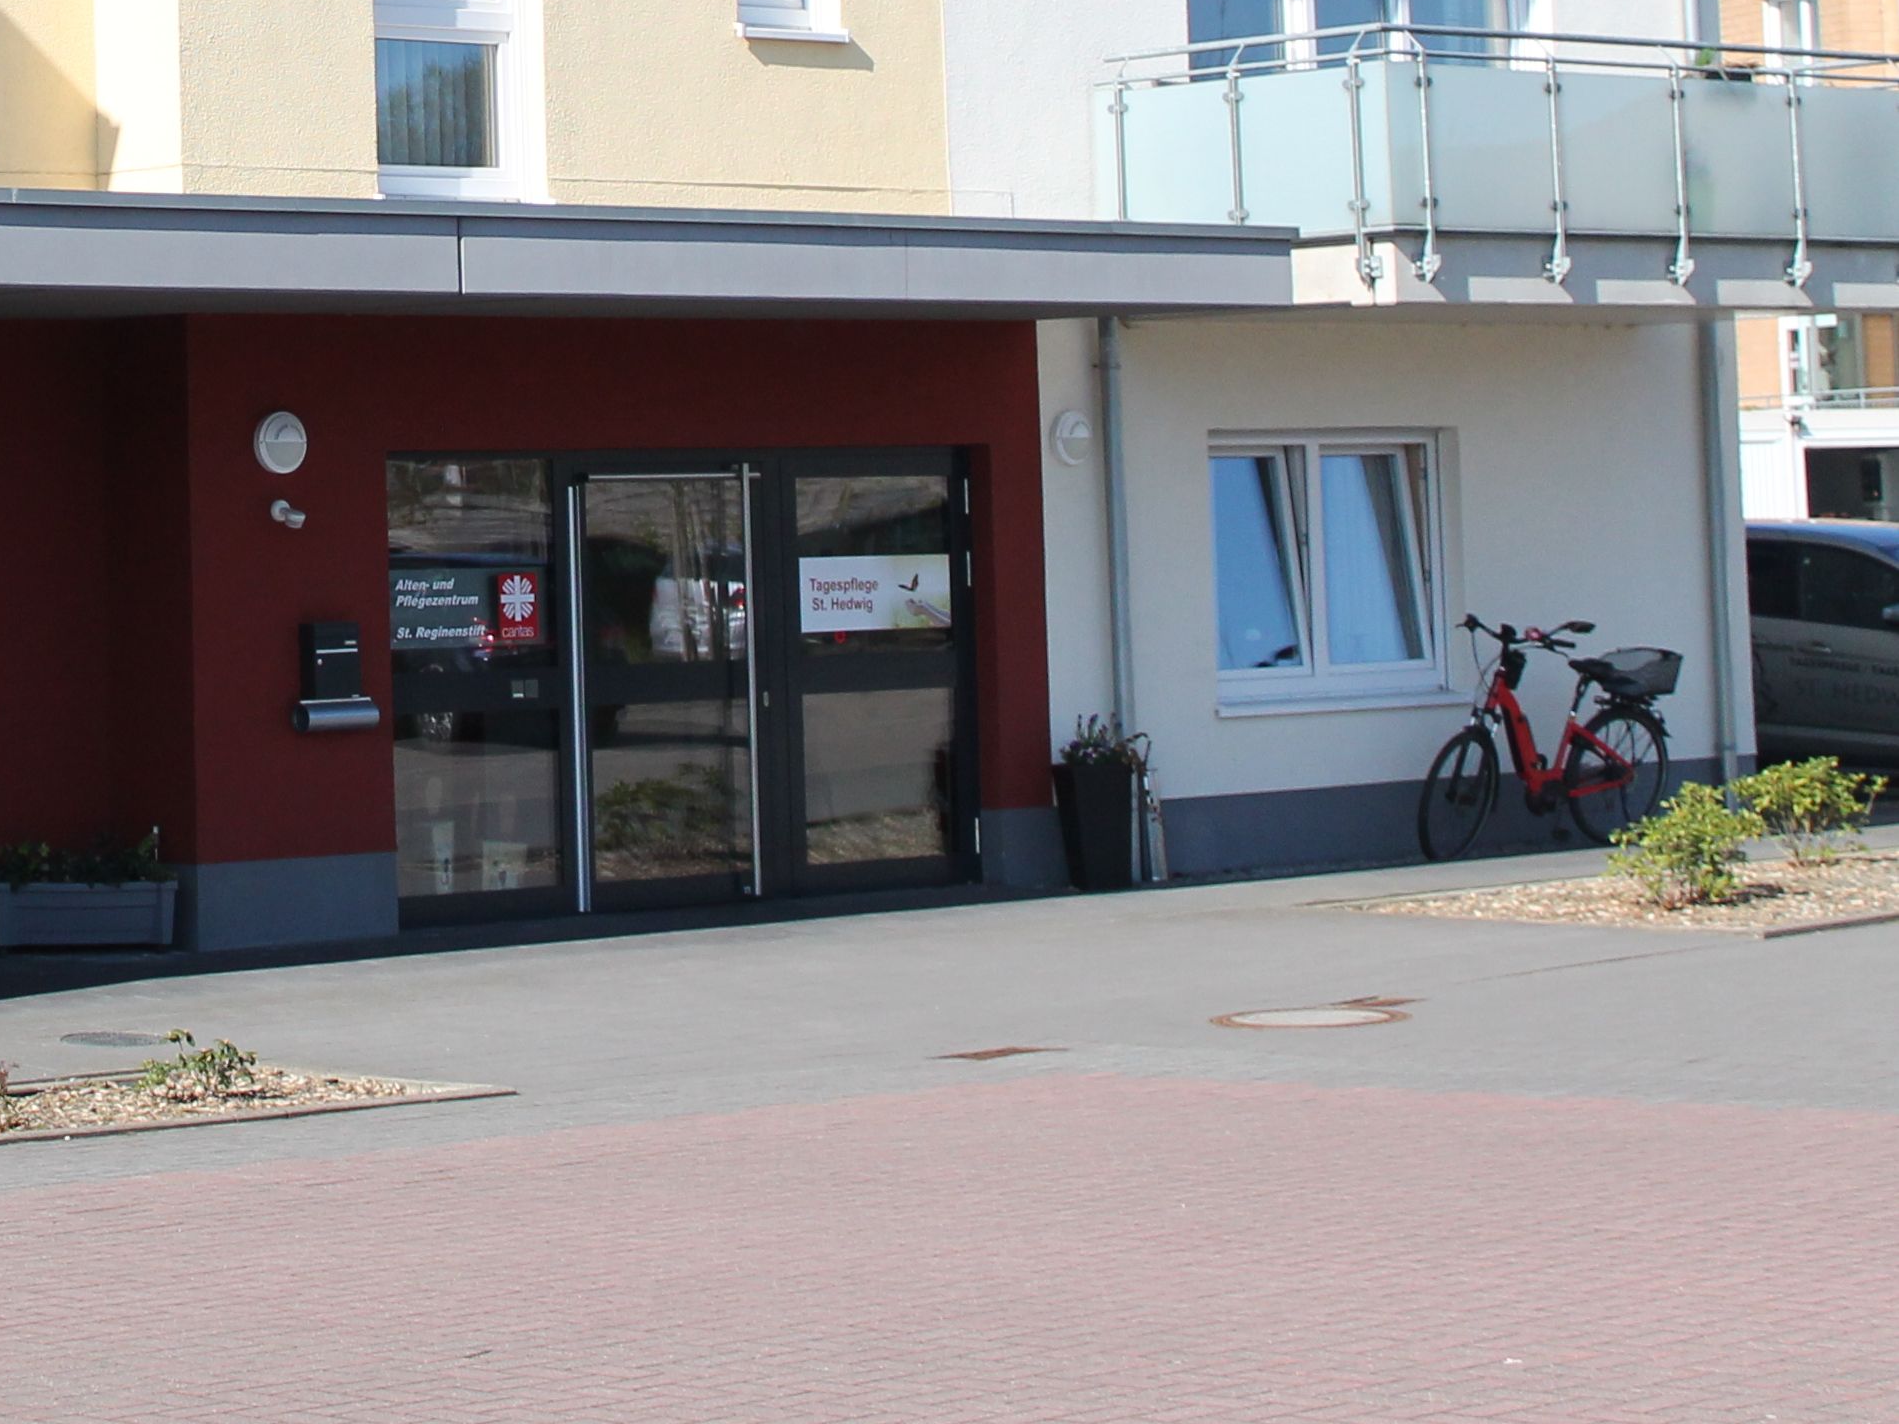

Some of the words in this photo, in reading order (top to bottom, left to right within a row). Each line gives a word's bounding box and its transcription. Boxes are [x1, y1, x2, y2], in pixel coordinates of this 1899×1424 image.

[395, 579, 430, 591] Alten-
[432, 578, 455, 590] und
[809, 577, 879, 594] Tagespflege
[395, 594, 479, 609] Pflegezentrum
[812, 598, 827, 611] St.
[831, 597, 873, 613] Hedwig
[396, 627, 412, 639] St.
[415, 625, 486, 641] Reginenstift
